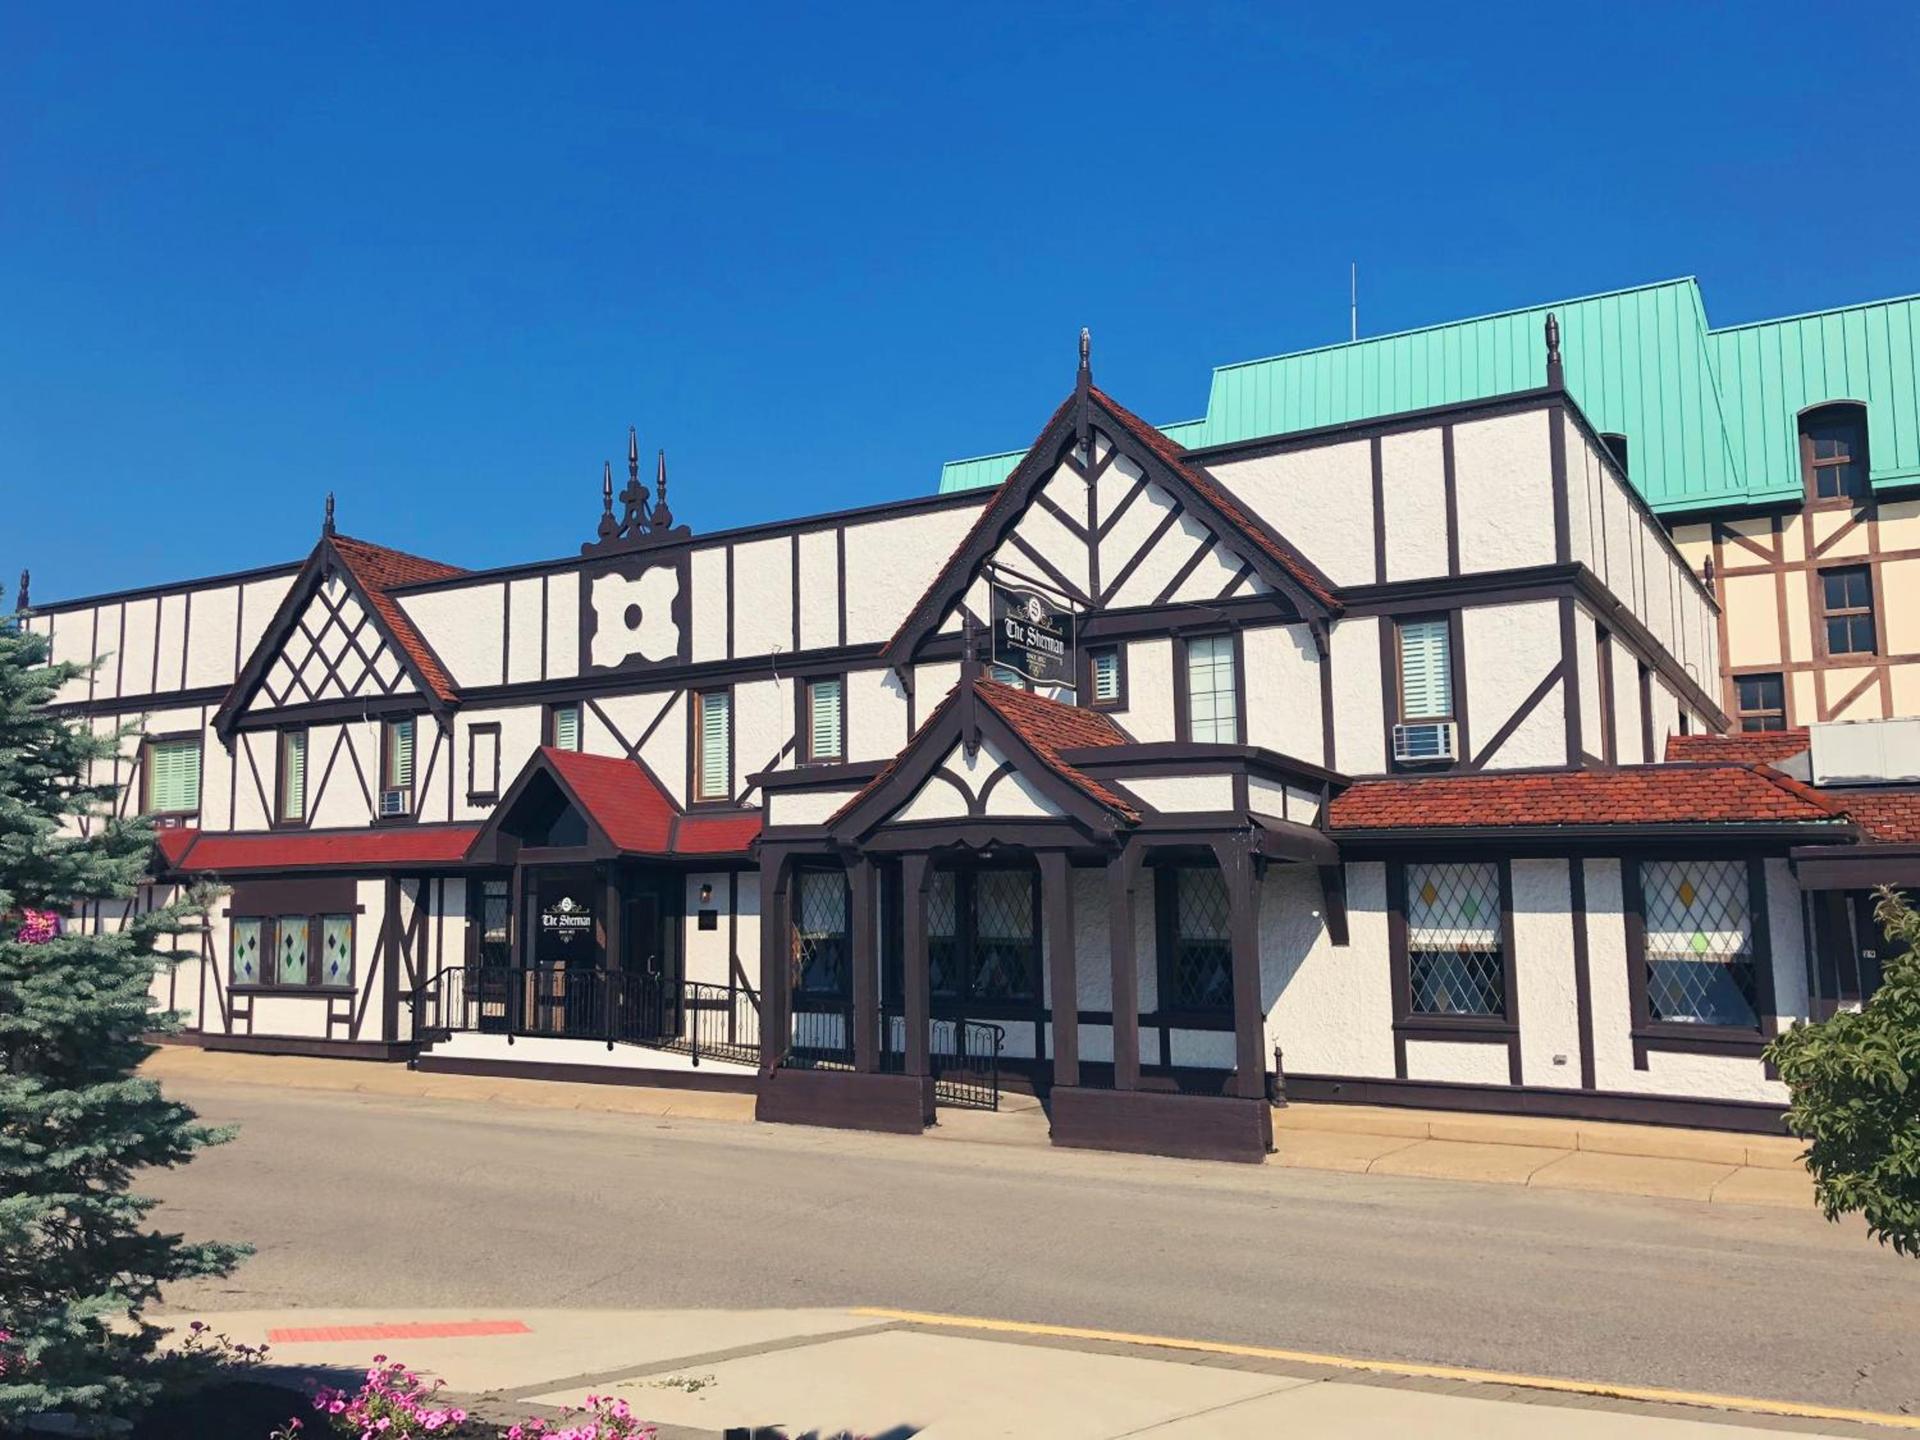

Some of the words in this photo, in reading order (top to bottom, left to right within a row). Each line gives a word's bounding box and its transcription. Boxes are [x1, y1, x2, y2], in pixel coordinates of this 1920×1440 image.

[1004, 617, 1024, 642] The
[1027, 626, 1064, 655] Sherman
[542, 915, 558, 926] The
[559, 915, 591, 927] Sherman
